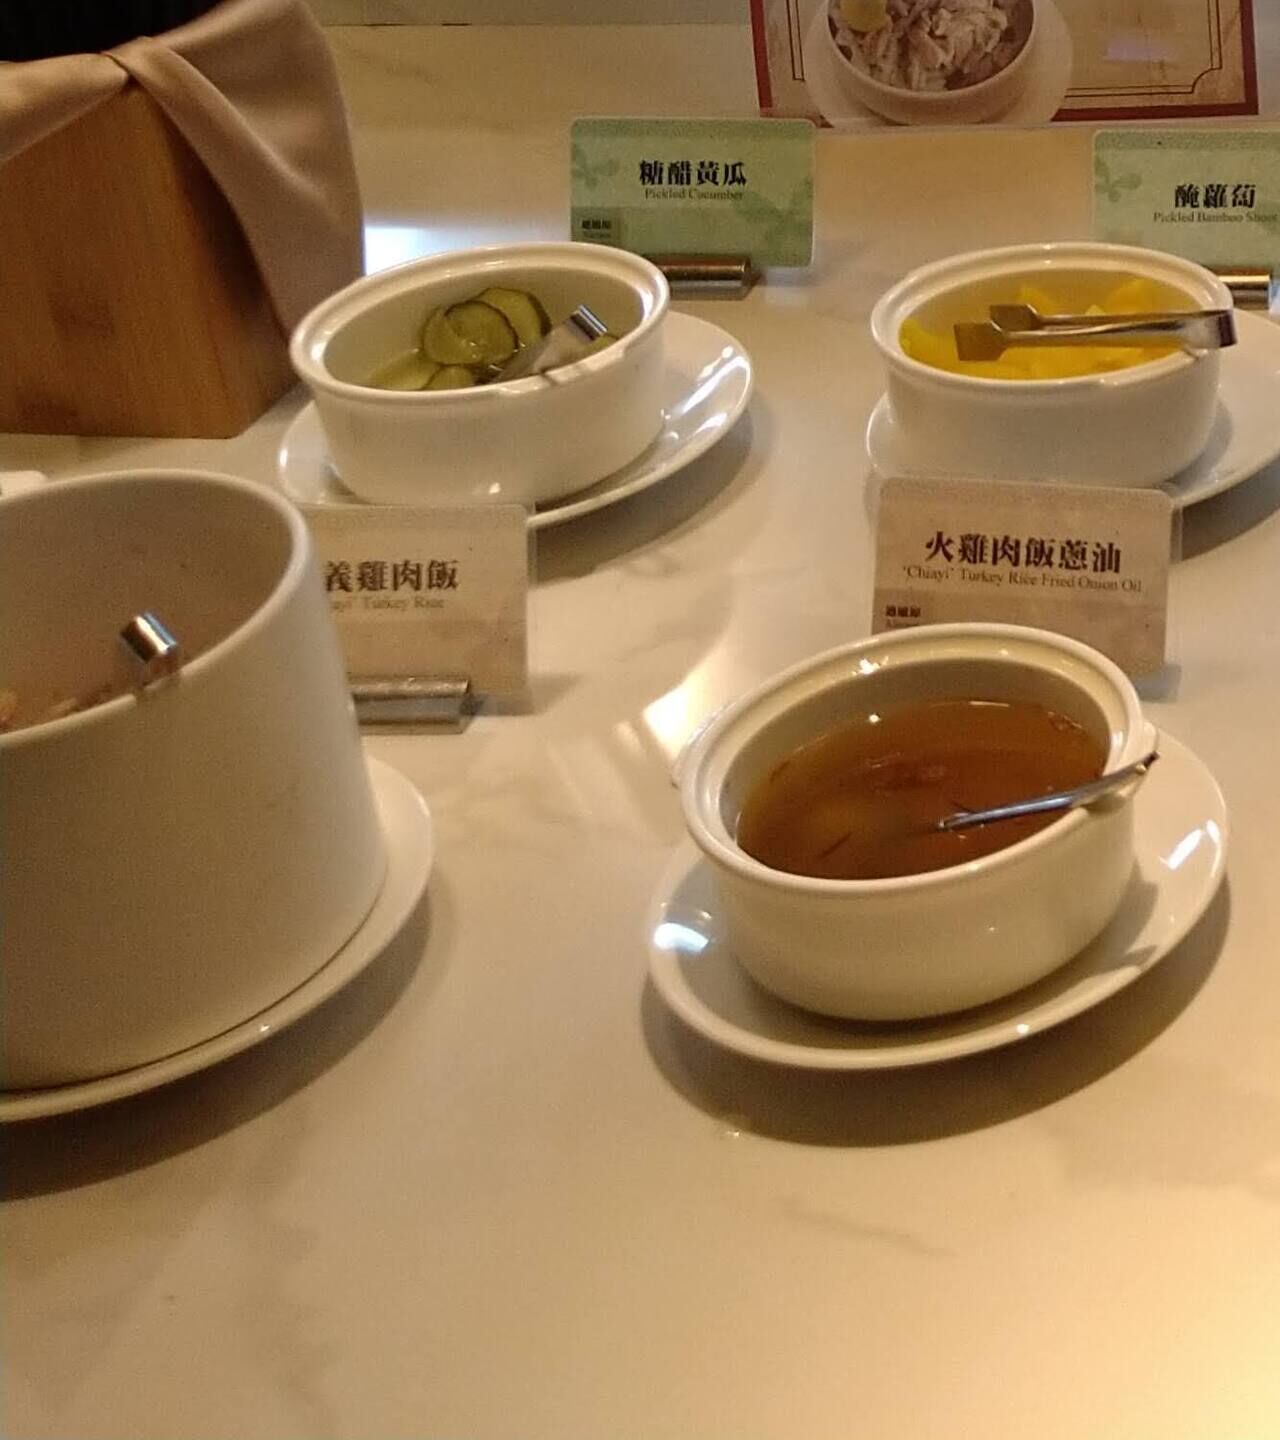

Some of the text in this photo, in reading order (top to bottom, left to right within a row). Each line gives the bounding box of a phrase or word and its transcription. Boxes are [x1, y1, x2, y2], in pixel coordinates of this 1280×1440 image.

[639, 159, 747, 186] 糖醋黃瓜
[644, 188, 686, 200] Pickled
[1153, 211, 1195, 223] Pickled
[925, 530, 1122, 574] 火雞肉飯蔥油
[959, 568, 1004, 588] Turkey
[1008, 572, 1038, 586] Rice
[1041, 574, 1075, 589] Fried
[1121, 579, 1143, 593] Oil
